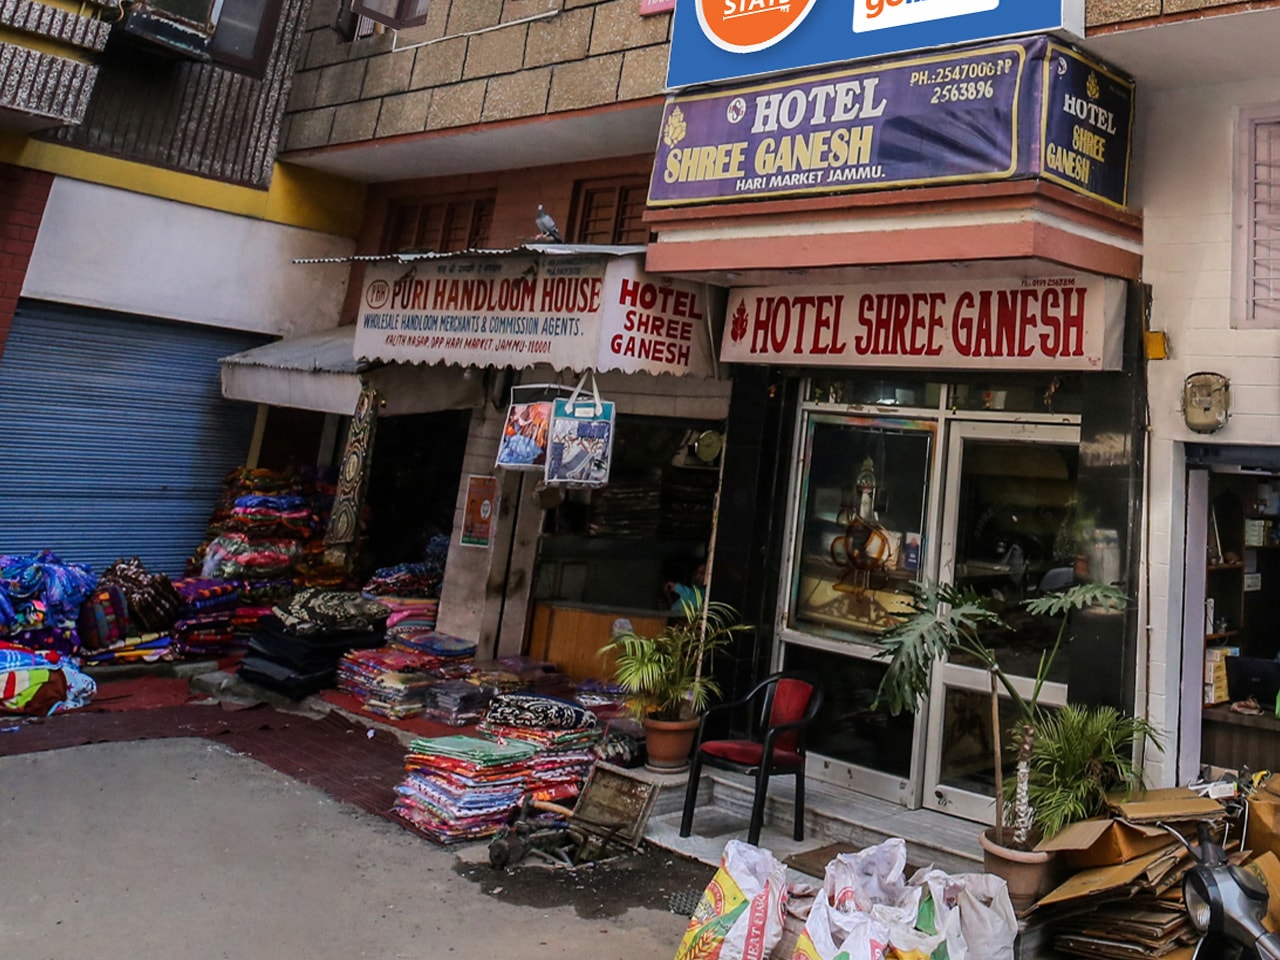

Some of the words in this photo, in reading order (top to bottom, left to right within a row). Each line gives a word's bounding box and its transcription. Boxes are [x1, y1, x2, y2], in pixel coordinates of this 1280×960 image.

[751, 77, 888, 134] HOTEL
[930, 80, 994, 104] 2563896
[1063, 93, 1117, 135] HOTEL
[664, 141, 748, 184] SHREE
[755, 125, 873, 176] GANESH
[1046, 142, 1090, 184] GANESH
[1072, 124, 1105, 163] SHREE
[736, 177, 766, 191] HARI
[769, 171, 824, 189] MARKET
[826, 165, 886, 183] JAMMU.
[390, 279, 430, 310] PURI
[432, 278, 538, 312] HANDLOOM
[540, 277, 603, 313] HOUSE
[619, 278, 702, 320] HOTEL
[363, 313, 399, 330] WHOLESALE
[401, 314, 439, 332] HANDLOOM
[439, 315, 480, 333] MERCHANTS
[480, 316, 487, 333] &
[489, 316, 539, 335] COMMISSION
[541, 317, 584, 336] AGENTS.
[624, 310, 693, 341] SHREE
[750, 295, 847, 355] HOTEL
[855, 293, 947, 356] SHREE
[952, 288, 1087, 357] GANESH
[611, 334, 690, 366] GANESH
